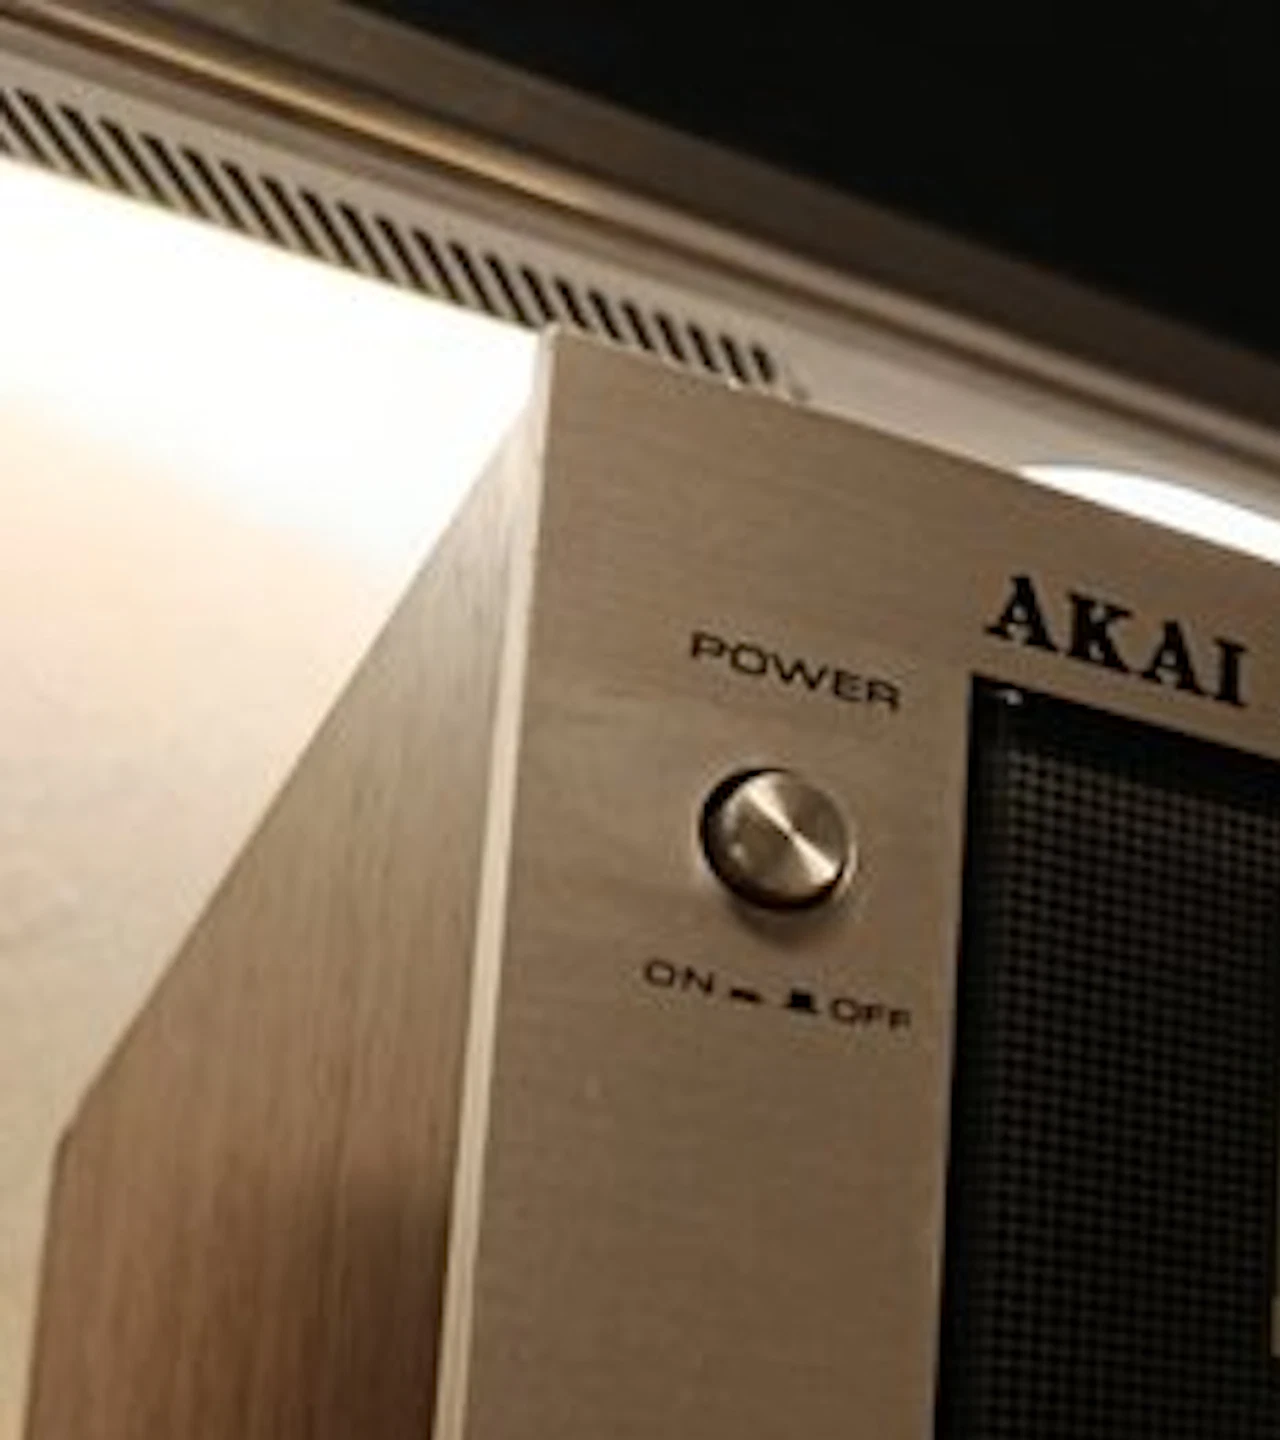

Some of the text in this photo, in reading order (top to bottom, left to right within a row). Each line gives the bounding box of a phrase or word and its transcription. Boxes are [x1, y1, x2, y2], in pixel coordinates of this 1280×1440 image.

[985, 574, 1249, 708] AKAI
[690, 630, 903, 712] POWER
[642, 957, 715, 994] ON
[829, 996, 912, 1029] OFF
